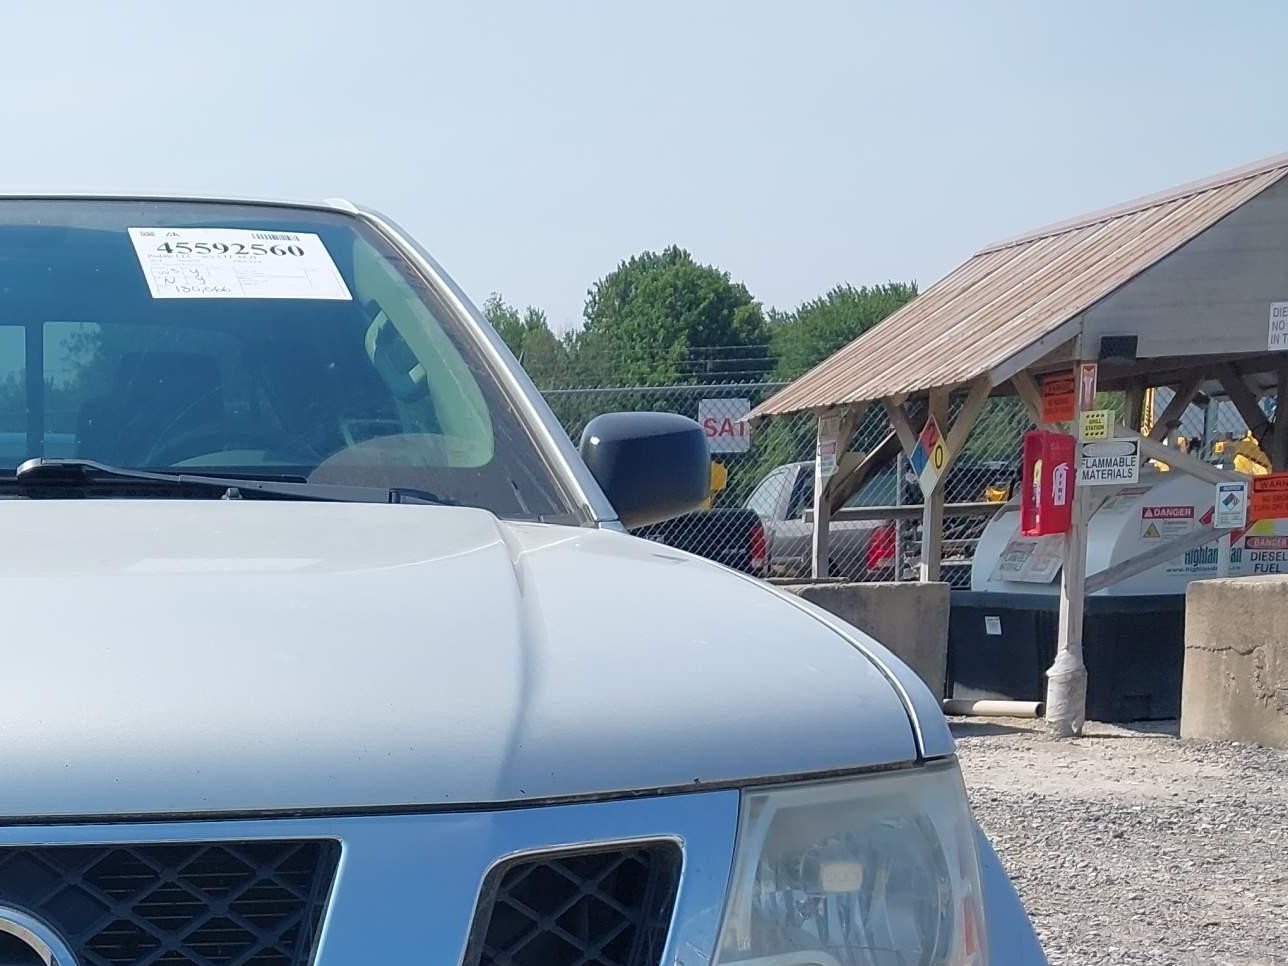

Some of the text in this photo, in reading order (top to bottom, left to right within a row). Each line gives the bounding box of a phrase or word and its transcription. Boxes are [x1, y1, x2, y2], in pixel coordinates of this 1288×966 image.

[156, 241, 305, 257] 45592560
[1081, 456, 1136, 469] FLAMMABLE
[1081, 467, 1133, 481] MATERIALS
[1153, 507, 1192, 518] DANGER
[1185, 546, 1219, 566] Highlan
[1250, 551, 1288, 561] DIESEL
[1254, 563, 1281, 573] FUEL
